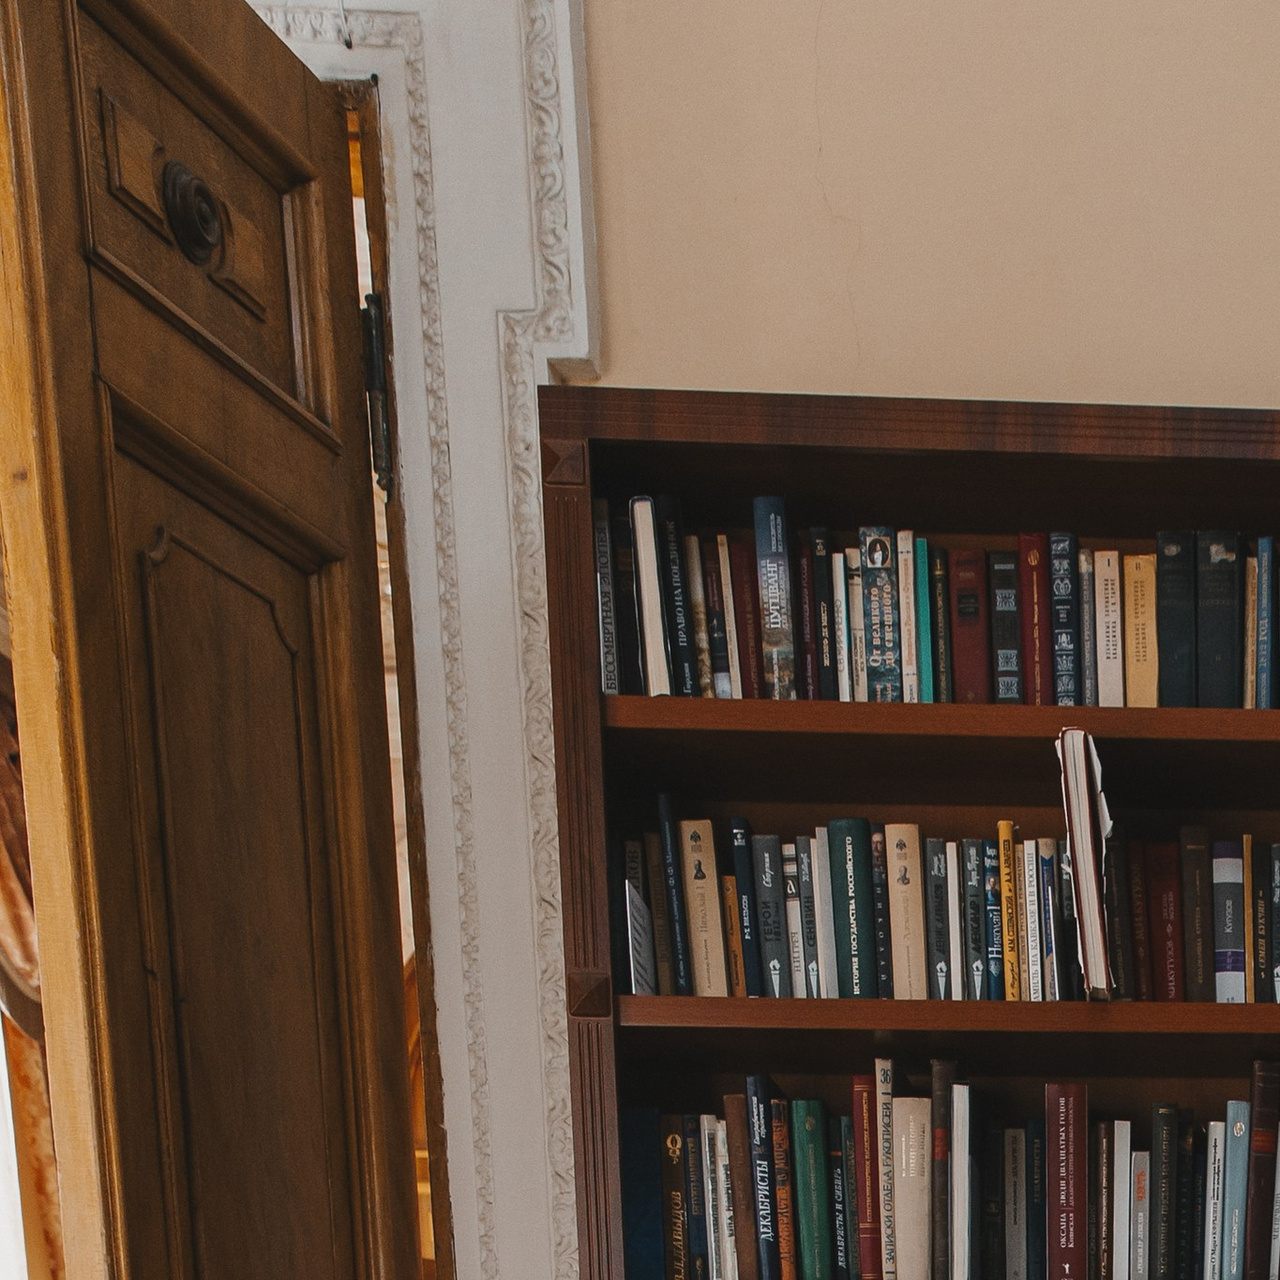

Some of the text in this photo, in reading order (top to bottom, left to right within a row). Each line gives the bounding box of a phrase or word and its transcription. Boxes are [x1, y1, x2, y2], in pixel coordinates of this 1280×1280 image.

[666, 520, 687, 646] ПРАВО НА ПОЕДИНОК
[883, 584, 893, 647] смешного
[601, 591, 616, 690] БЕССМЕРТНАЯ
[845, 837, 860, 995] ИСТОРИЯ ГОСУДАРСТВА РОССИЙСКОГО
[988, 911, 1002, 958] Николай
[756, 1160, 774, 1241] ДЕКАБРИСТЫ
[881, 1102, 894, 1264] ЗАПИСКИ ОТДЕЛА РУКОПИСЕЙ
[836, 1212, 846, 1268] ДЕКАБРИСТЫ
